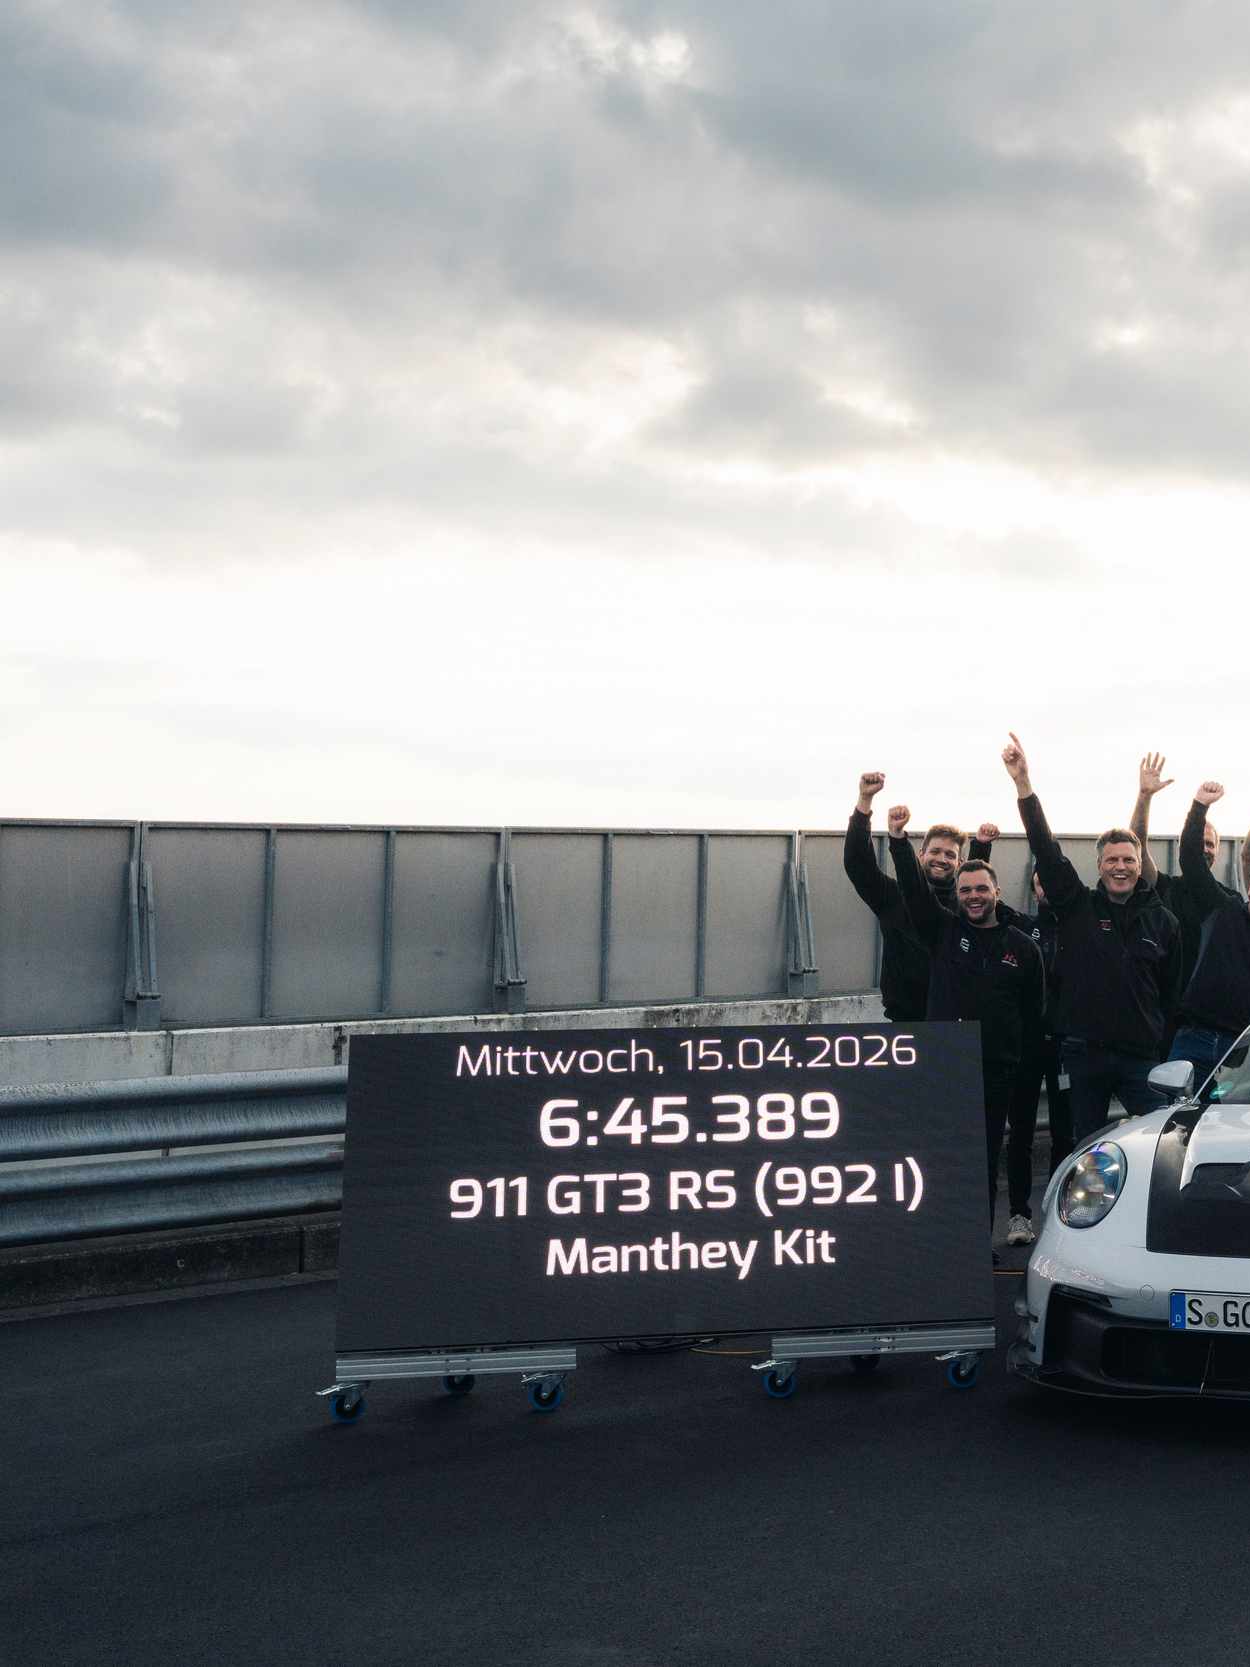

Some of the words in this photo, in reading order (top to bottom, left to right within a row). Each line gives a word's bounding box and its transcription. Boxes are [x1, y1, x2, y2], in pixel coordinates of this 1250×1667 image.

[457, 1039, 664, 1076] Mittwoch,
[680, 1035, 916, 1070] 15.04.2026
[540, 1092, 840, 1147] 6:45.389
[450, 1177, 528, 1218] 911
[547, 1172, 650, 1214] GT3
[669, 1169, 737, 1210] RS
[755, 1162, 877, 1217] (992
[546, 1230, 758, 1280] Manthey
[774, 1228, 836, 1265] Kit
[1175, 1315, 1181, 1323] D
[1187, 1298, 1203, 1326] S
